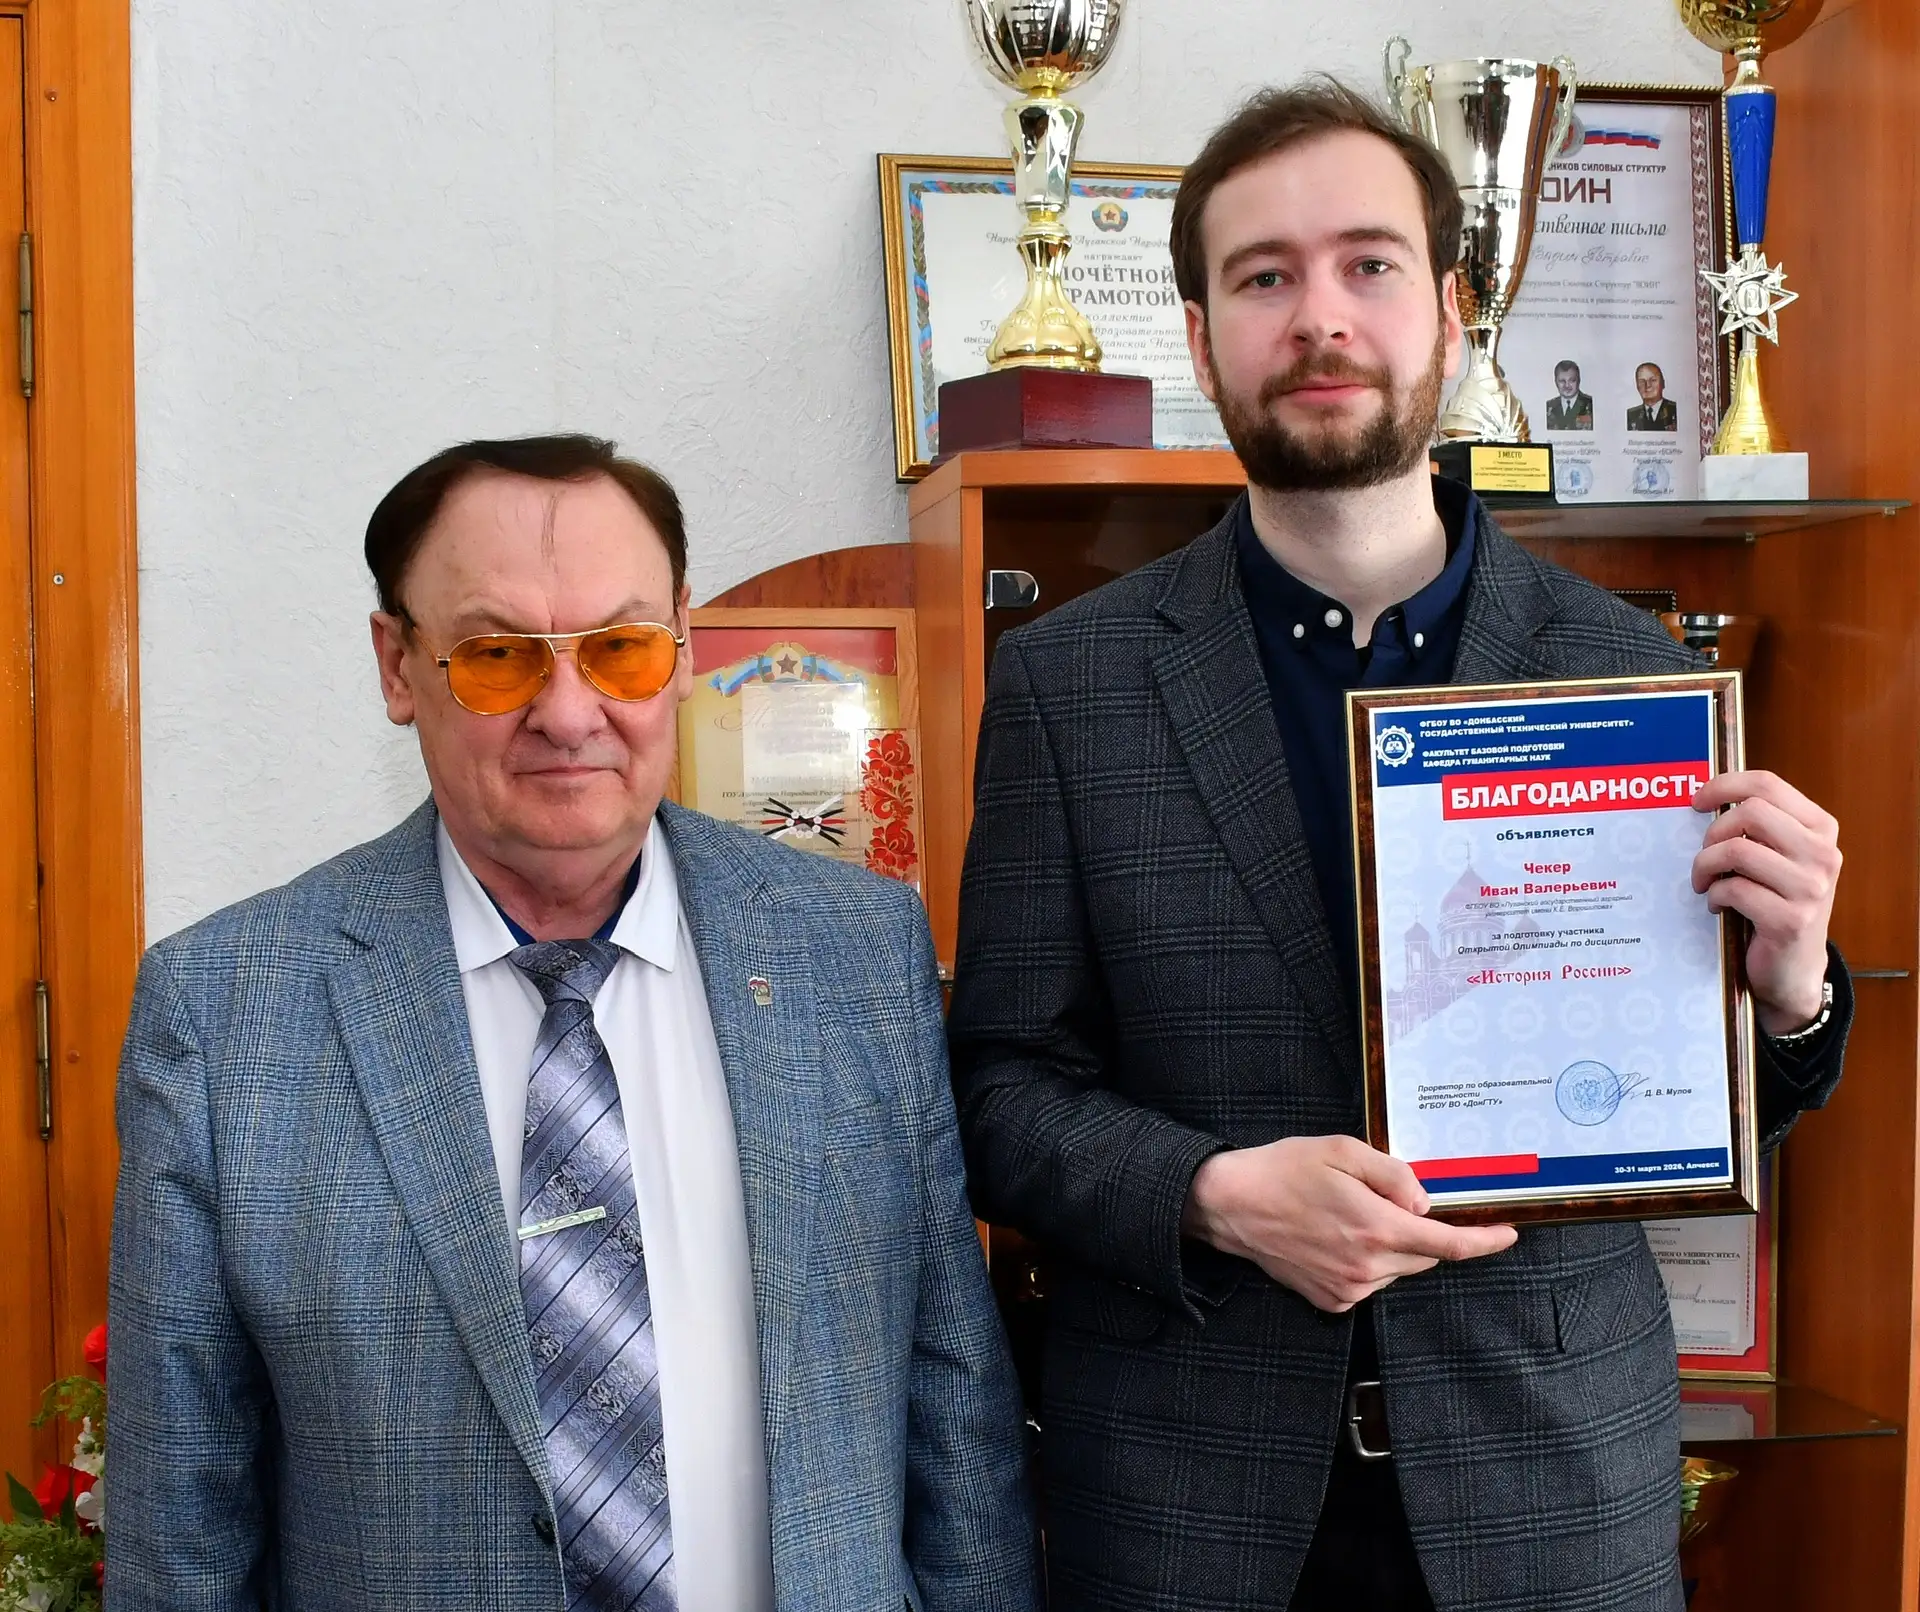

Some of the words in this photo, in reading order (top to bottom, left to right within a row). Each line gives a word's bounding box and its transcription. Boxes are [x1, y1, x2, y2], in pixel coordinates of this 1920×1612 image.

[1549, 163, 1579, 172] НИКОВ
[1581, 163, 1623, 172] СИЛОВЫХ
[1626, 165, 1667, 173] СТРУКТУР
[1542, 177, 1611, 204] ОИН
[1536, 214, 1606, 235] ственное
[1611, 222, 1667, 236] письмо
[1129, 236, 1169, 248] Народн
[1463, 715, 1525, 725] «ДОНБАССКИЙ
[1420, 725, 1504, 738] ГОСУДАРСТВЕННЫЙ
[1506, 722, 1568, 733] ТЕХНИЧЕСКИЙ
[1569, 719, 1635, 730] УНИВЕРСИТЕТ»
[1422, 748, 1469, 757] ФАКУЛЬТЕТ
[1471, 745, 1509, 755] БАЗОВОЙ
[1510, 742, 1565, 753] ПОДГОТОВКИ
[1423, 759, 1461, 768] КАФЕДРА
[1462, 755, 1528, 766] ГУМАНИТАРНЫХ
[1529, 753, 1551, 761] НАУК
[1451, 774, 1705, 809] БЛАГОДАРНОСТЬ
[1496, 827, 1594, 841] объявляется
[1524, 863, 1571, 875] Чекер
[1480, 885, 1518, 897] Иван
[1524, 881, 1617, 895] Валерьевич
[1504, 929, 1555, 942] подготовку
[1558, 927, 1605, 938] участника
[1458, 944, 1511, 955] Открытой
[1513, 940, 1568, 951] Олимпиады
[1584, 937, 1641, 947] дисциплине
[1467, 969, 1552, 986] «История
[1561, 964, 1632, 980] России»
[1418, 1083, 1464, 1094] Проректор
[1477, 1077, 1553, 1089] образовательной
[1666, 1087, 1692, 1095] Мулов
[1418, 1091, 1481, 1101] деятельности
[1418, 1101, 1446, 1110] ФГБОУ
[1448, 1100, 1461, 1108] ВО
[1462, 1098, 1503, 1108] «ДонГТУ»
[1614, 1166, 1636, 1174] 30-31
[1637, 1165, 1662, 1173] марта
[1663, 1163, 1685, 1171] 2026,
[1686, 1161, 1720, 1169] Алчевск
